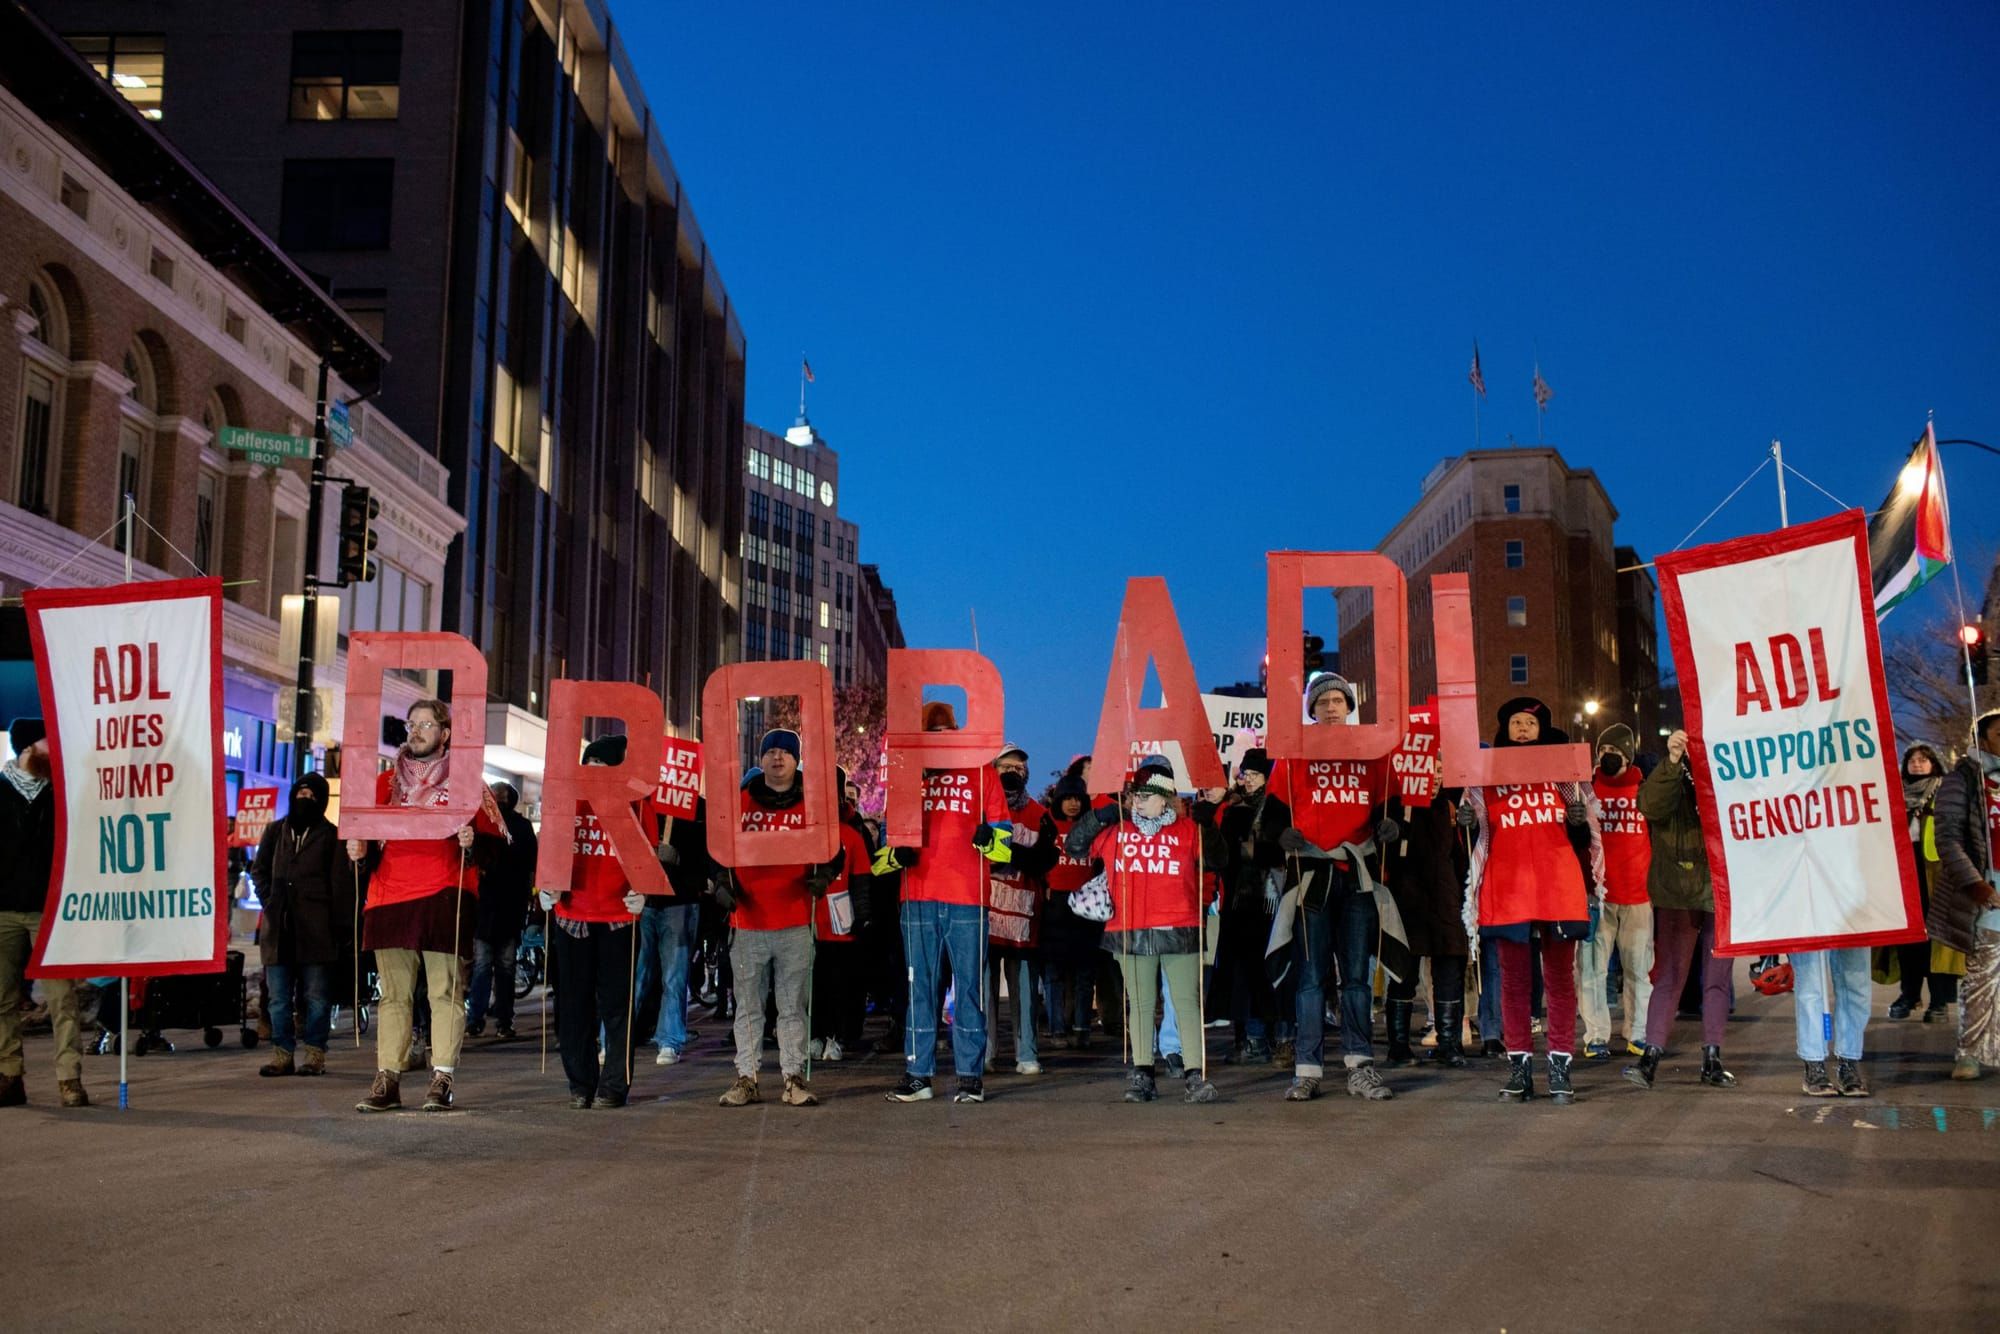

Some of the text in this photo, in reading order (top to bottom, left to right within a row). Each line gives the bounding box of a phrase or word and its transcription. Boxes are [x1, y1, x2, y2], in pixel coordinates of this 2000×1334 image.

[226, 430, 291, 454] Jefferson
[251, 451, 280, 464] 1800
[93, 642, 171, 705] ADL
[1735, 627, 1841, 717] ADL
[1223, 711, 1264, 729] JEWS
[96, 713, 164, 751] LOVES
[1130, 740, 1162, 755] AZA
[1402, 732, 1434, 752] LET
[1712, 718, 1876, 782] SUPPORTS
[666, 747, 697, 769] LET
[1392, 753, 1434, 775] GAZA
[1309, 762, 1367, 775] NOT IN
[96, 762, 174, 801] TRUMP
[926, 775, 969, 786] TOP
[1317, 775, 1360, 789] OUR
[1399, 776, 1429, 795] IVE
[244, 794, 271, 808] LET
[656, 786, 693, 810] LIVE
[1312, 789, 1369, 805] NAME
[1508, 792, 1556, 809] OUR
[924, 799, 971, 814] RAEL
[1728, 782, 1882, 842] GENOCIDE
[237, 809, 275, 824] GAZA
[741, 811, 802, 824] NOT IN
[1500, 808, 1565, 829] NAME
[1600, 810, 1644, 821] RMING
[239, 824, 266, 839] LIV
[1604, 822, 1643, 834] RAEL
[99, 812, 172, 874] NOT
[1117, 832, 1179, 846] NOT IN
[1124, 844, 1171, 859] OUR
[1115, 858, 1181, 875] NAME
[62, 887, 213, 922] COMMUNITIES
